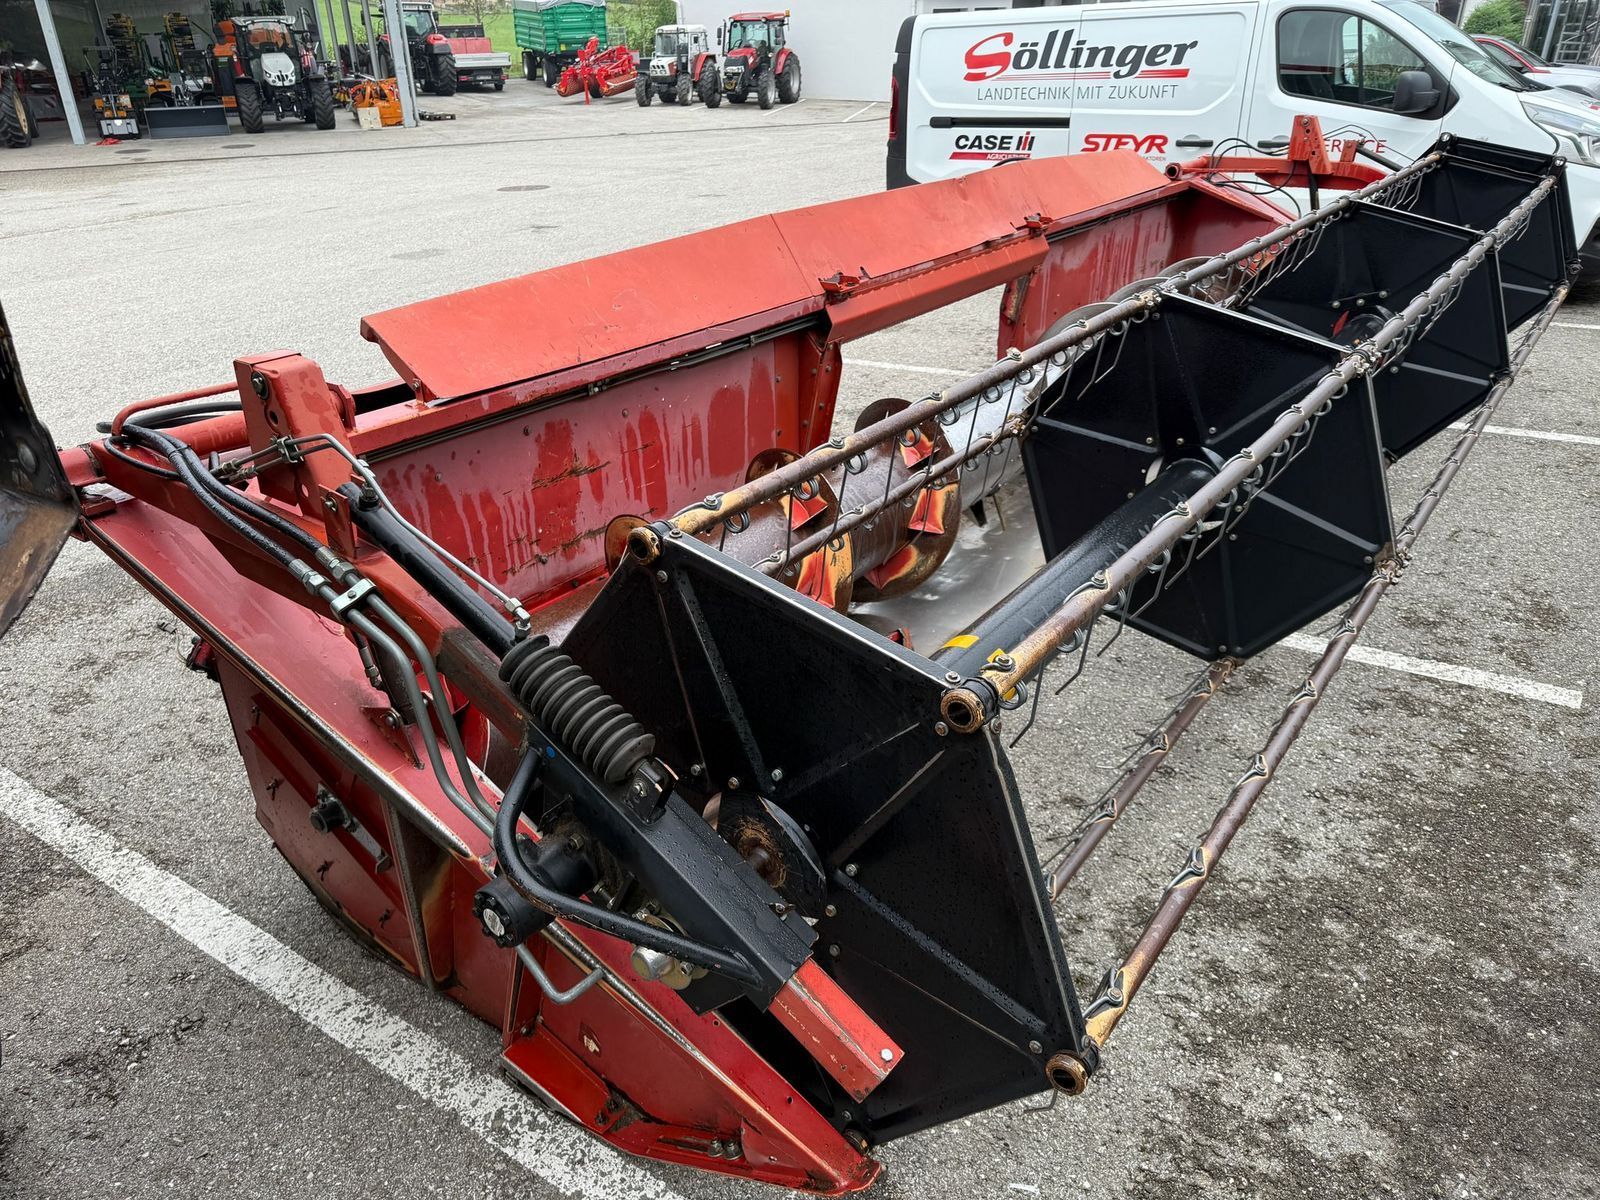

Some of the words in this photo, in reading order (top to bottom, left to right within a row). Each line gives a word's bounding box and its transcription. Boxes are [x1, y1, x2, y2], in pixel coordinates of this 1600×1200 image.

[963, 28, 1199, 82] Söllinger
[977, 86, 1071, 101] LANDTECHNIK
[1077, 86, 1103, 100] MIT
[1108, 84, 1179, 100] ZUKUNFT
[955, 134, 1013, 151] CASE
[1080, 133, 1169, 154] STEYR
[1325, 138, 1387, 154] ERCE
